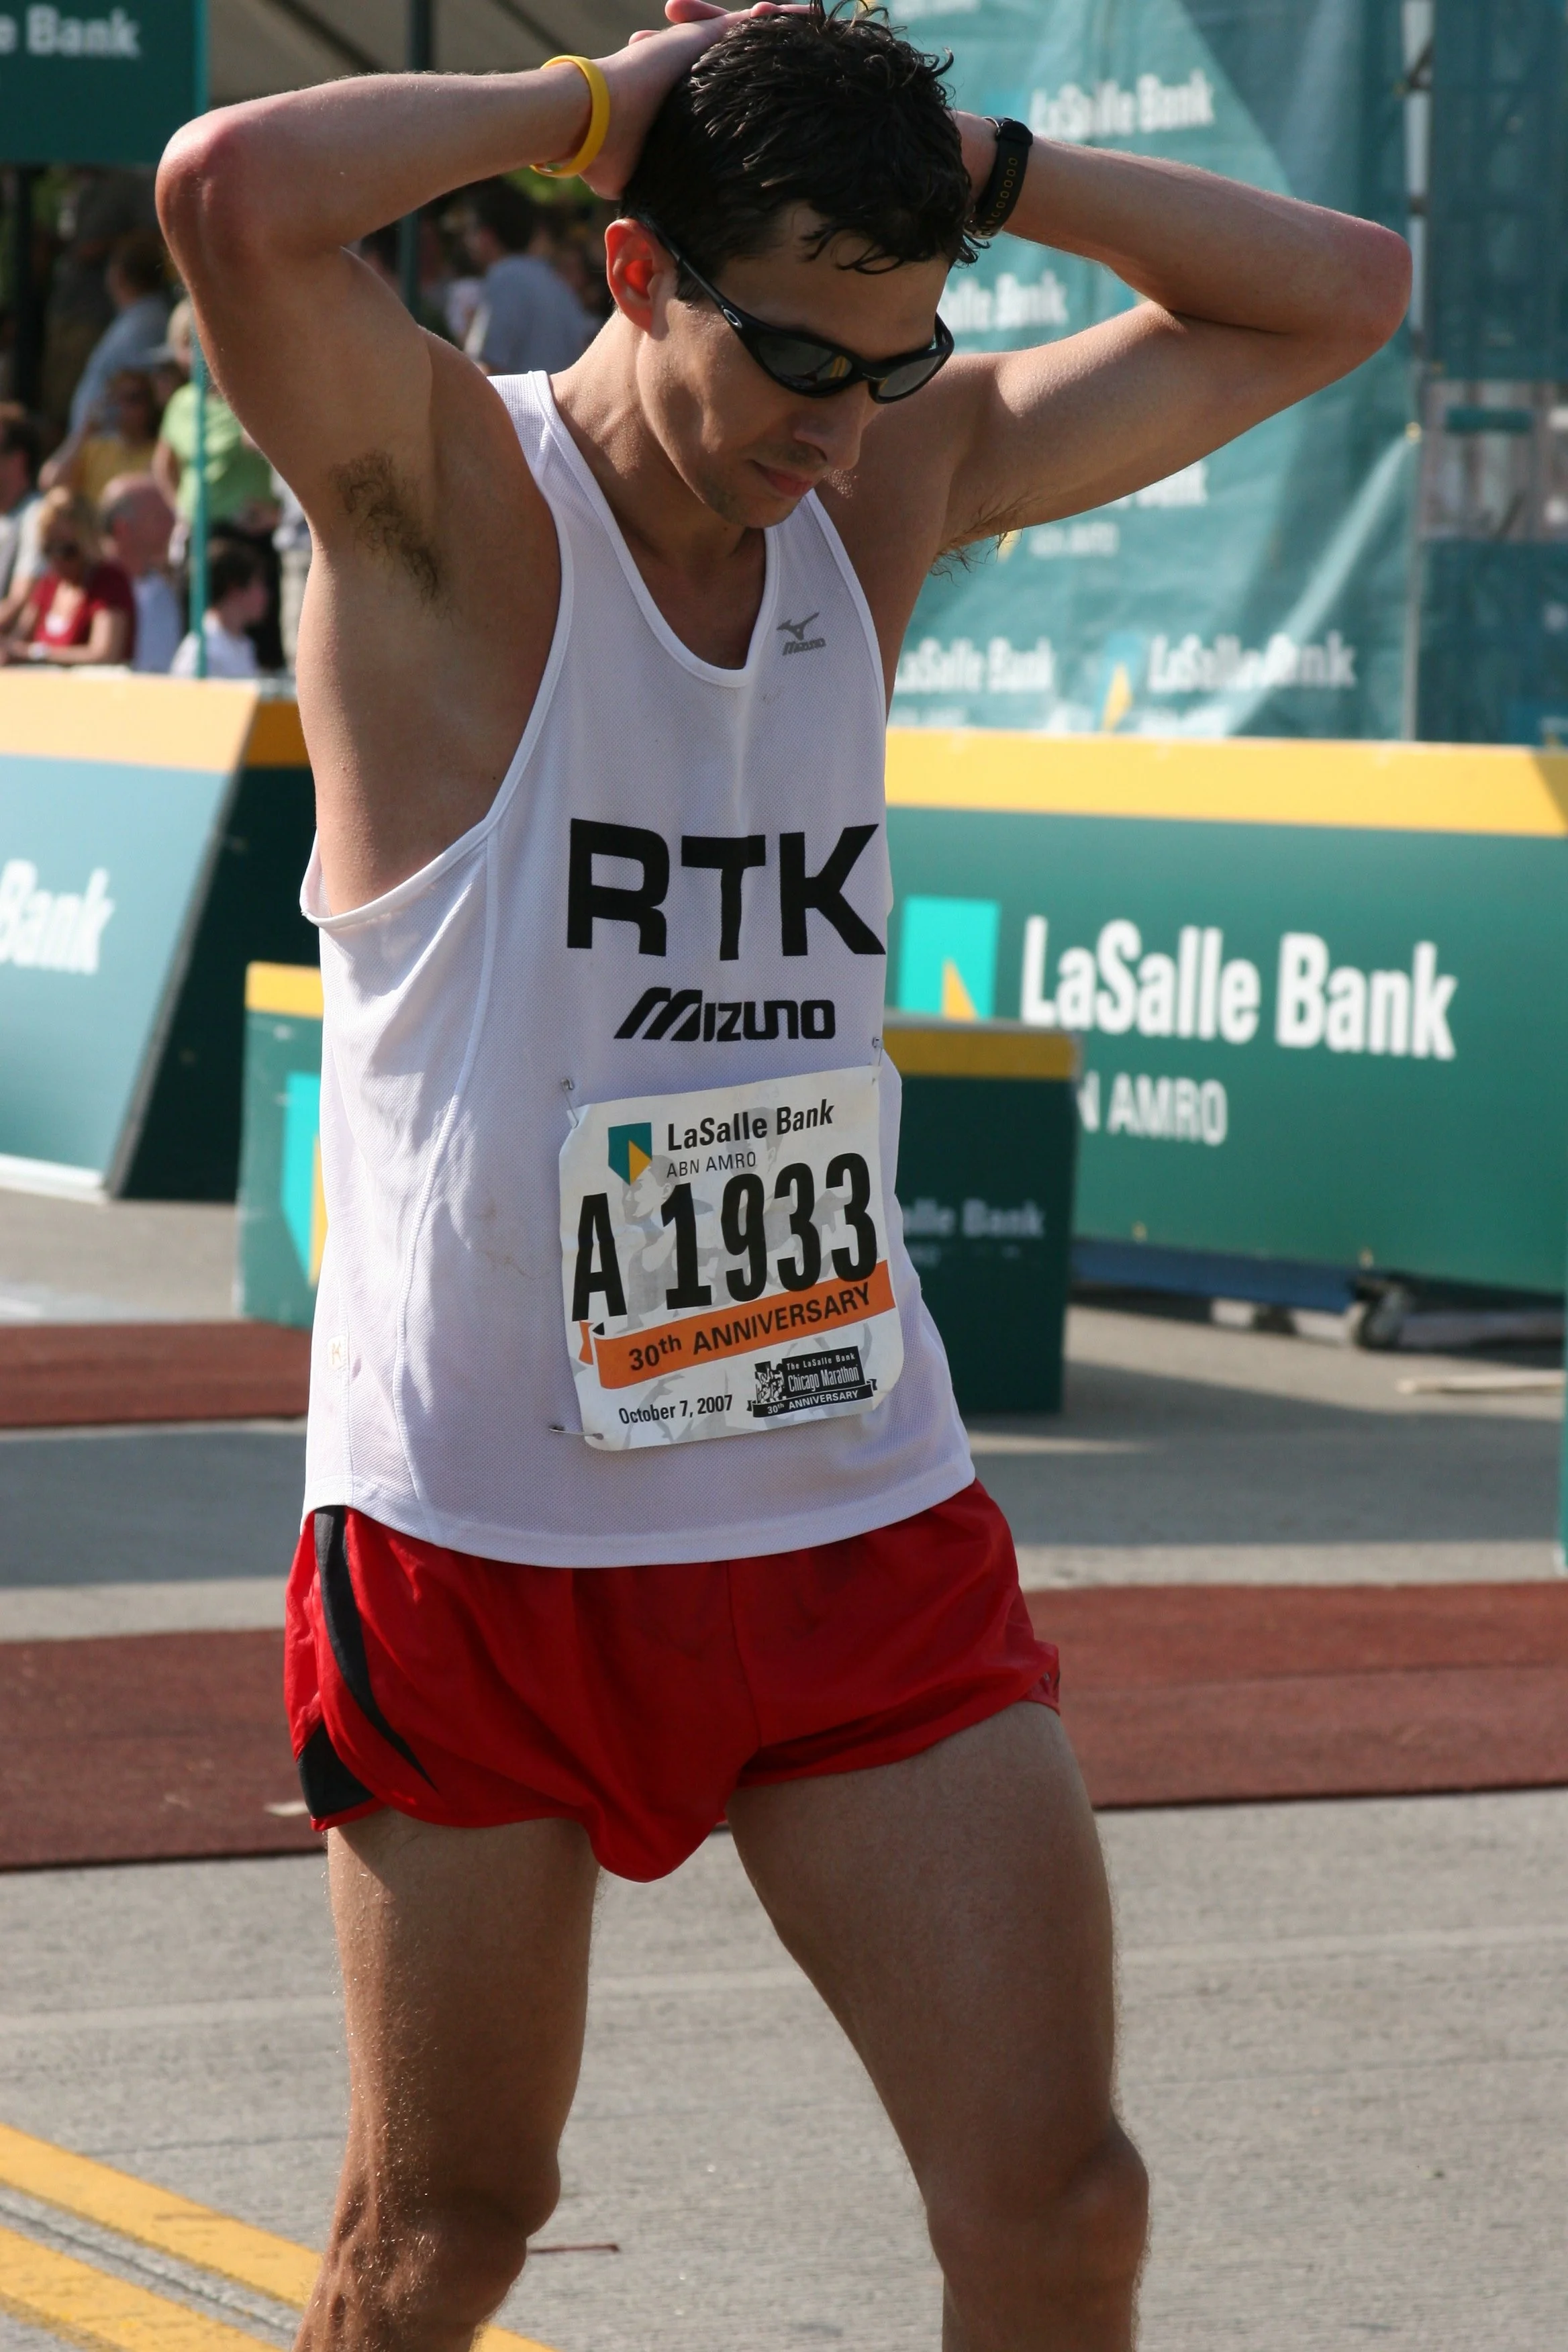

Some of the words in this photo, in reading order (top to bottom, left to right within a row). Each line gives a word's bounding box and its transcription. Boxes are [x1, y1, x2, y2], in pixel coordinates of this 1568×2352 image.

[28, 4, 140, 58] Bank
[1137, 69, 1214, 132] Bank
[996, 271, 1069, 328] Bank
[987, 636, 1055, 692] Bank
[0, 858, 116, 975] Bank
[567, 818, 886, 961] RTK
[1020, 915, 1261, 1044] LaSalle
[1275, 932, 1458, 1061] Bank
[668, 1112, 768, 1151] LaSalle
[777, 1099, 834, 1135] Bank
[1108, 1072, 1228, 1147] AMRO
[667, 1159, 699, 1178] ABN
[706, 1151, 756, 1172] AMRO
[572, 1193, 627, 1322] A
[660, 1153, 877, 1310] 1933
[963, 1197, 1044, 1238] Bank
[628, 1334, 682, 1371] 30th
[693, 1282, 870, 1355] ANNIVERSARY
[787, 1363, 799, 1371] The
[803, 1357, 832, 1369] LaSalle
[836, 1353, 855, 1363] Bank
[788, 1373, 820, 1393] Chicago
[820, 1365, 860, 1387] Marathon
[619, 1404, 676, 1424] October
[679, 1400, 694, 1418] 7,
[697, 1394, 732, 1414] 2007
[767, 1402, 785, 1414] 30th
[789, 1390, 859, 1410] ANNIVERSARY
